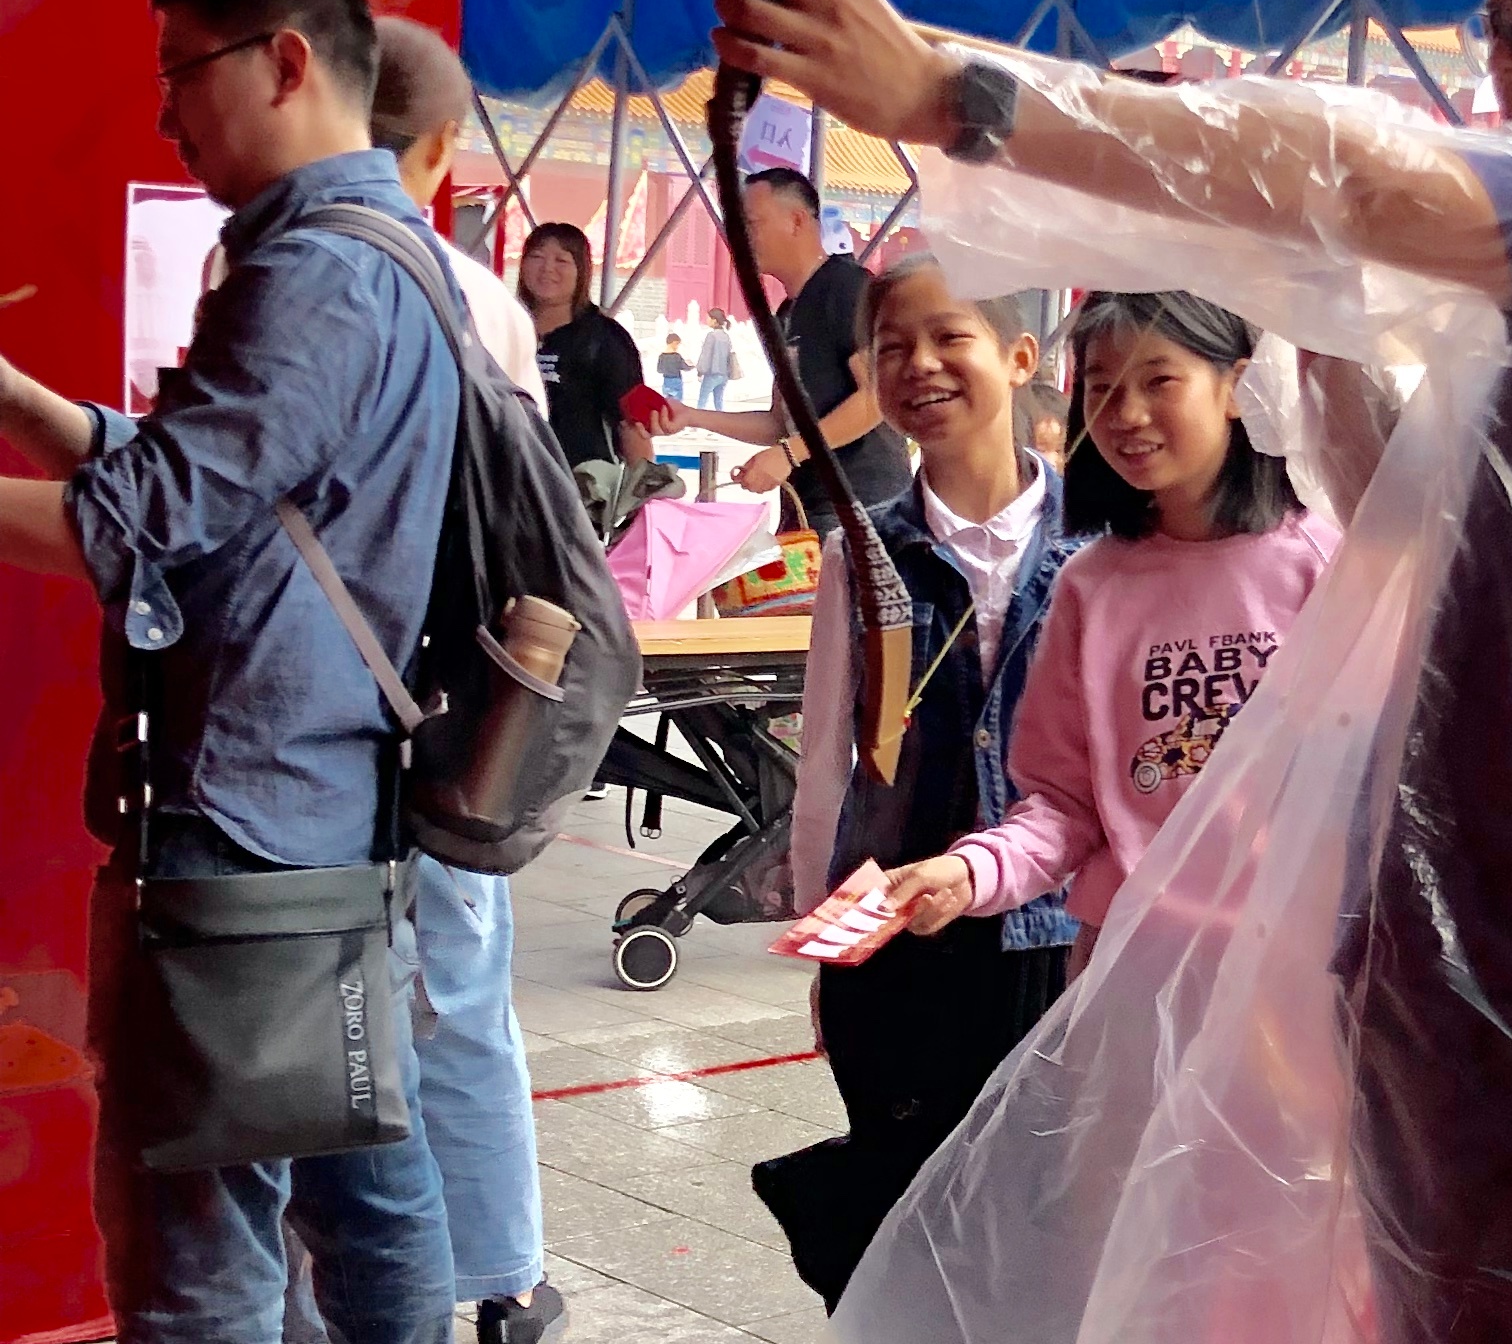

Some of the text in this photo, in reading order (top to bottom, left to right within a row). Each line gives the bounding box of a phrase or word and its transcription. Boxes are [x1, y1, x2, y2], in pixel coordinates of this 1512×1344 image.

[1144, 644, 1279, 682] BABY
[340, 980, 372, 1110] ZORO PAUL
